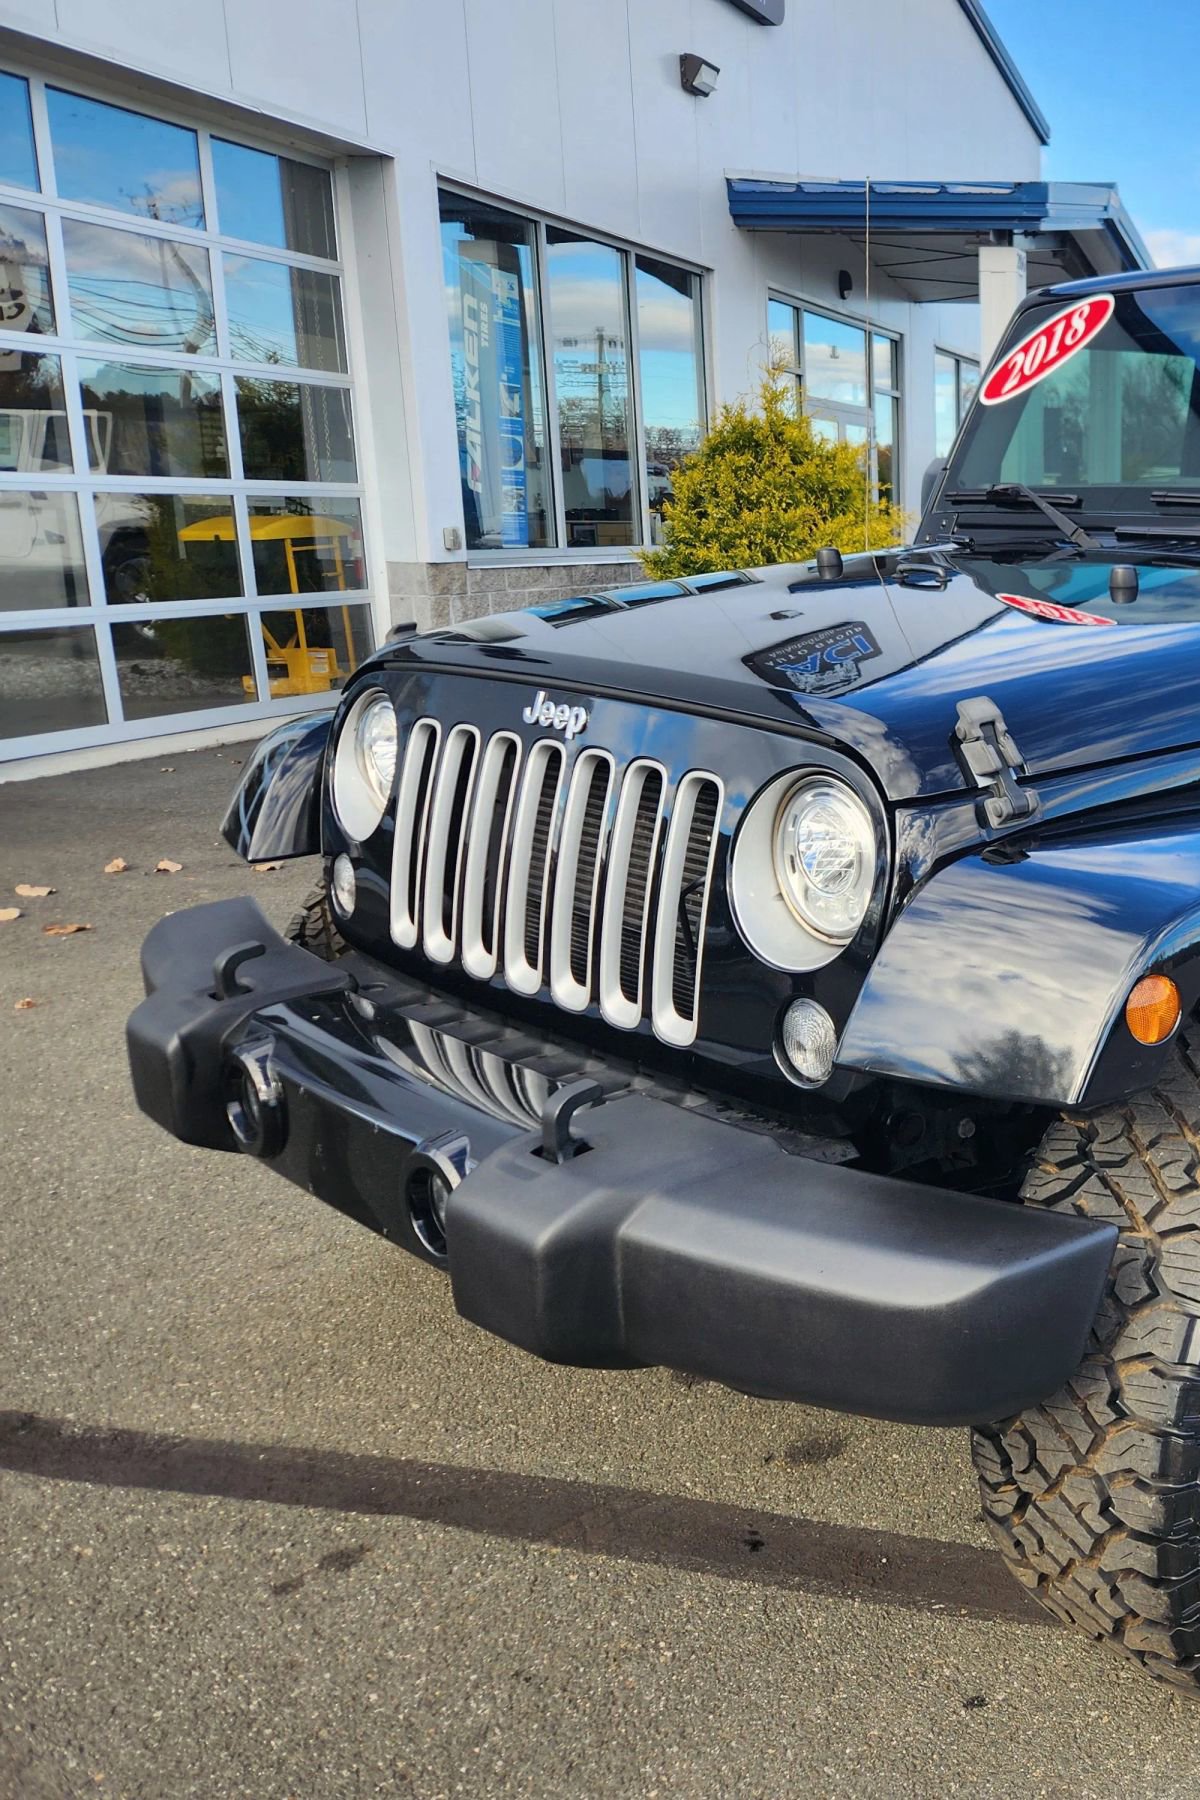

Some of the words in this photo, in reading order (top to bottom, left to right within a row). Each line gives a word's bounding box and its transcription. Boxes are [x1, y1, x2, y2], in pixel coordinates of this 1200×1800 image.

[480, 301, 489, 348] TIRES
[1001, 303, 1090, 395] 2018
[463, 293, 483, 493] FALKEN
[522, 690, 587, 740] Jeep
